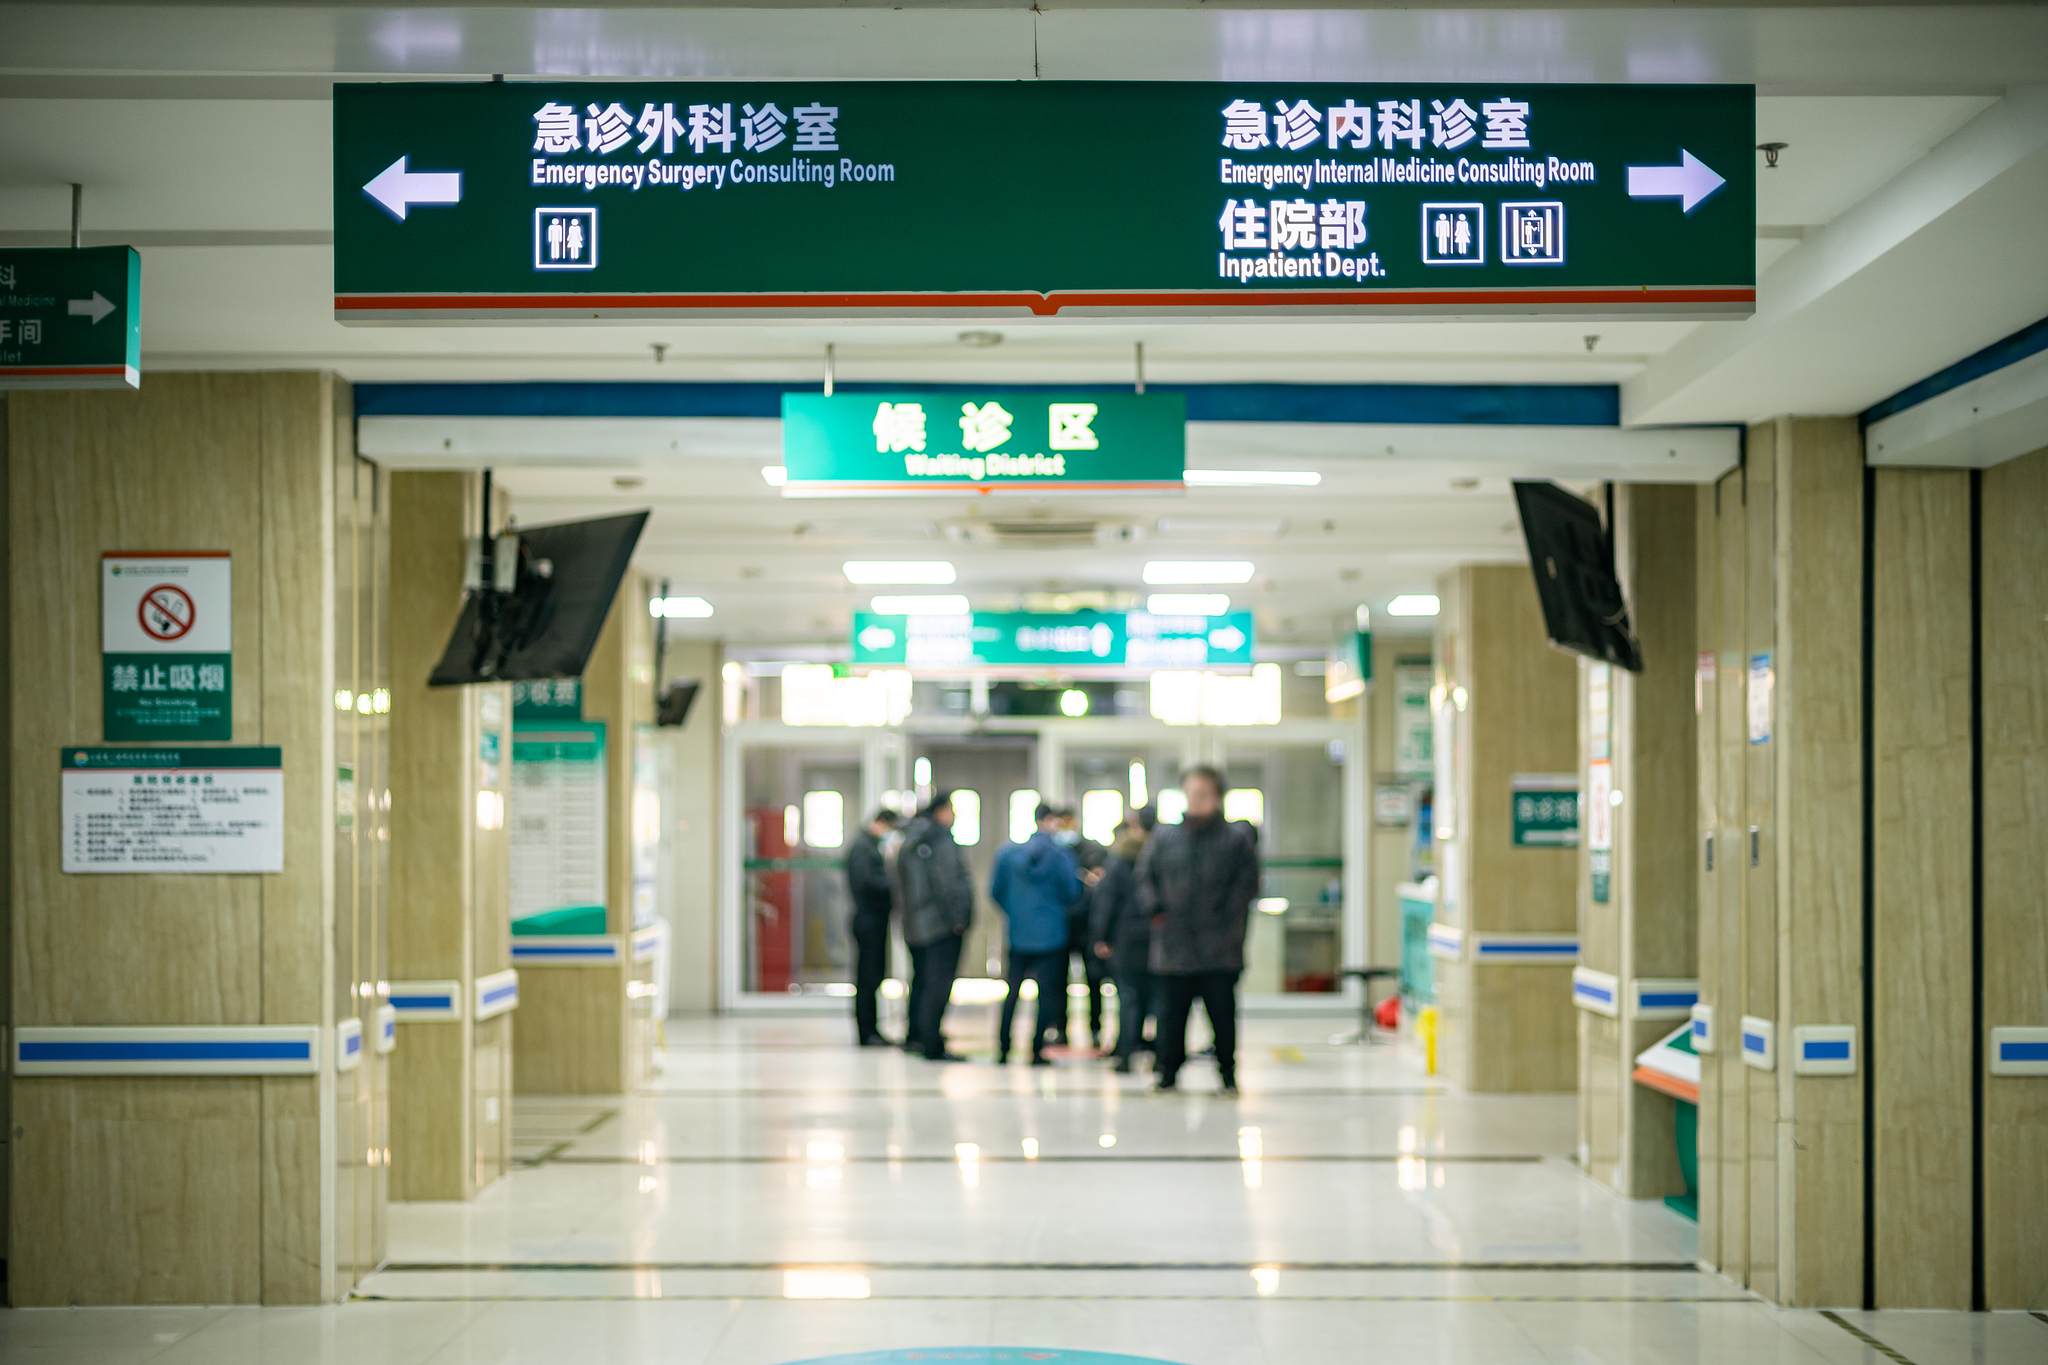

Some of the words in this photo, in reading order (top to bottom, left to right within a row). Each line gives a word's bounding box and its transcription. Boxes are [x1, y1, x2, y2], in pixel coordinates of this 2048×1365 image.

[533, 102, 838, 154] 急诊外科诊室
[1221, 98, 1530, 151] 急诊内科诊室
[532, 158, 645, 190] Emergency
[648, 158, 727, 190] Surgery
[730, 158, 835, 188] Consulting
[840, 158, 895, 182] Room
[1220, 158, 1312, 190] Emergency
[1315, 157, 1379, 184] Internal
[1381, 157, 1455, 183] Medicine
[1457, 157, 1545, 188] Consulting
[1548, 157, 1595, 182] Room
[1219, 199, 1367, 251] 住院部
[1219, 251, 1322, 283] Inpatient
[1325, 252, 1386, 282] Dept.
[873, 401, 1099, 453] 候诊区
[904, 453, 985, 480] Waiting
[986, 453, 1066, 477] District
[111, 663, 224, 693] 禁止吸烟
